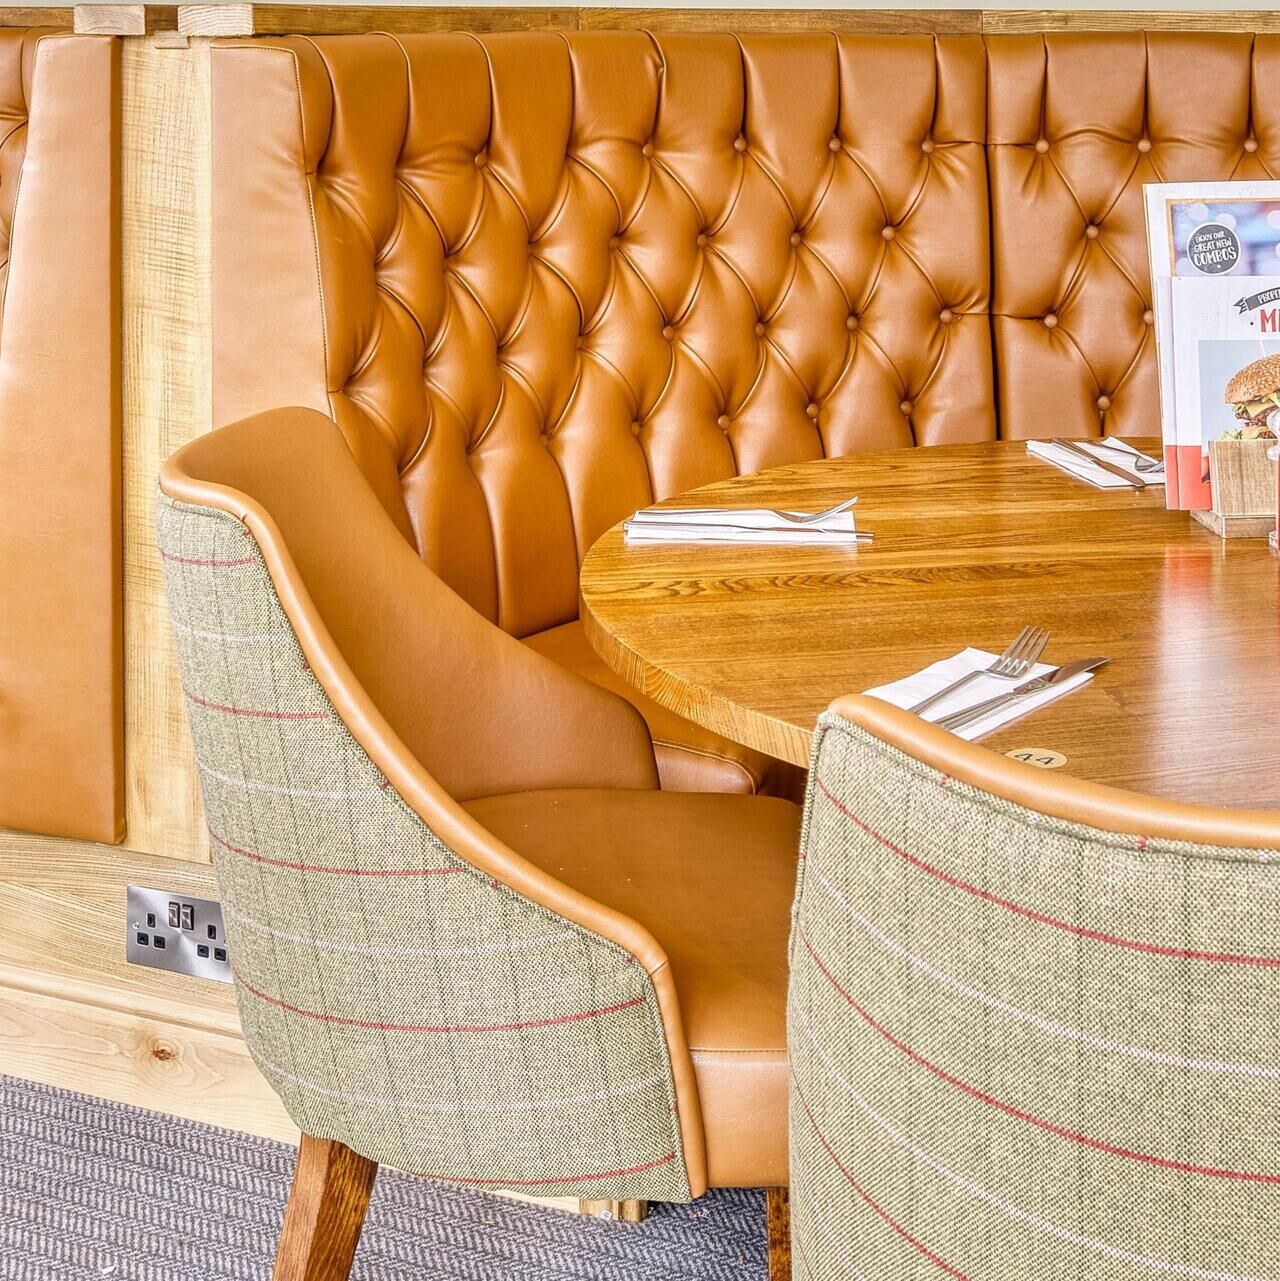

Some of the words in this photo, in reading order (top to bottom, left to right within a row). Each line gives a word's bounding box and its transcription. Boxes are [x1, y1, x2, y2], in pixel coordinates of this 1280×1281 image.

[1194, 240, 1216, 253] GREAT
[1216, 237, 1232, 249] NEW
[1195, 233, 1213, 243] ENJOY
[1213, 231, 1226, 240] OUR
[1194, 246, 1237, 267] COMBOS
